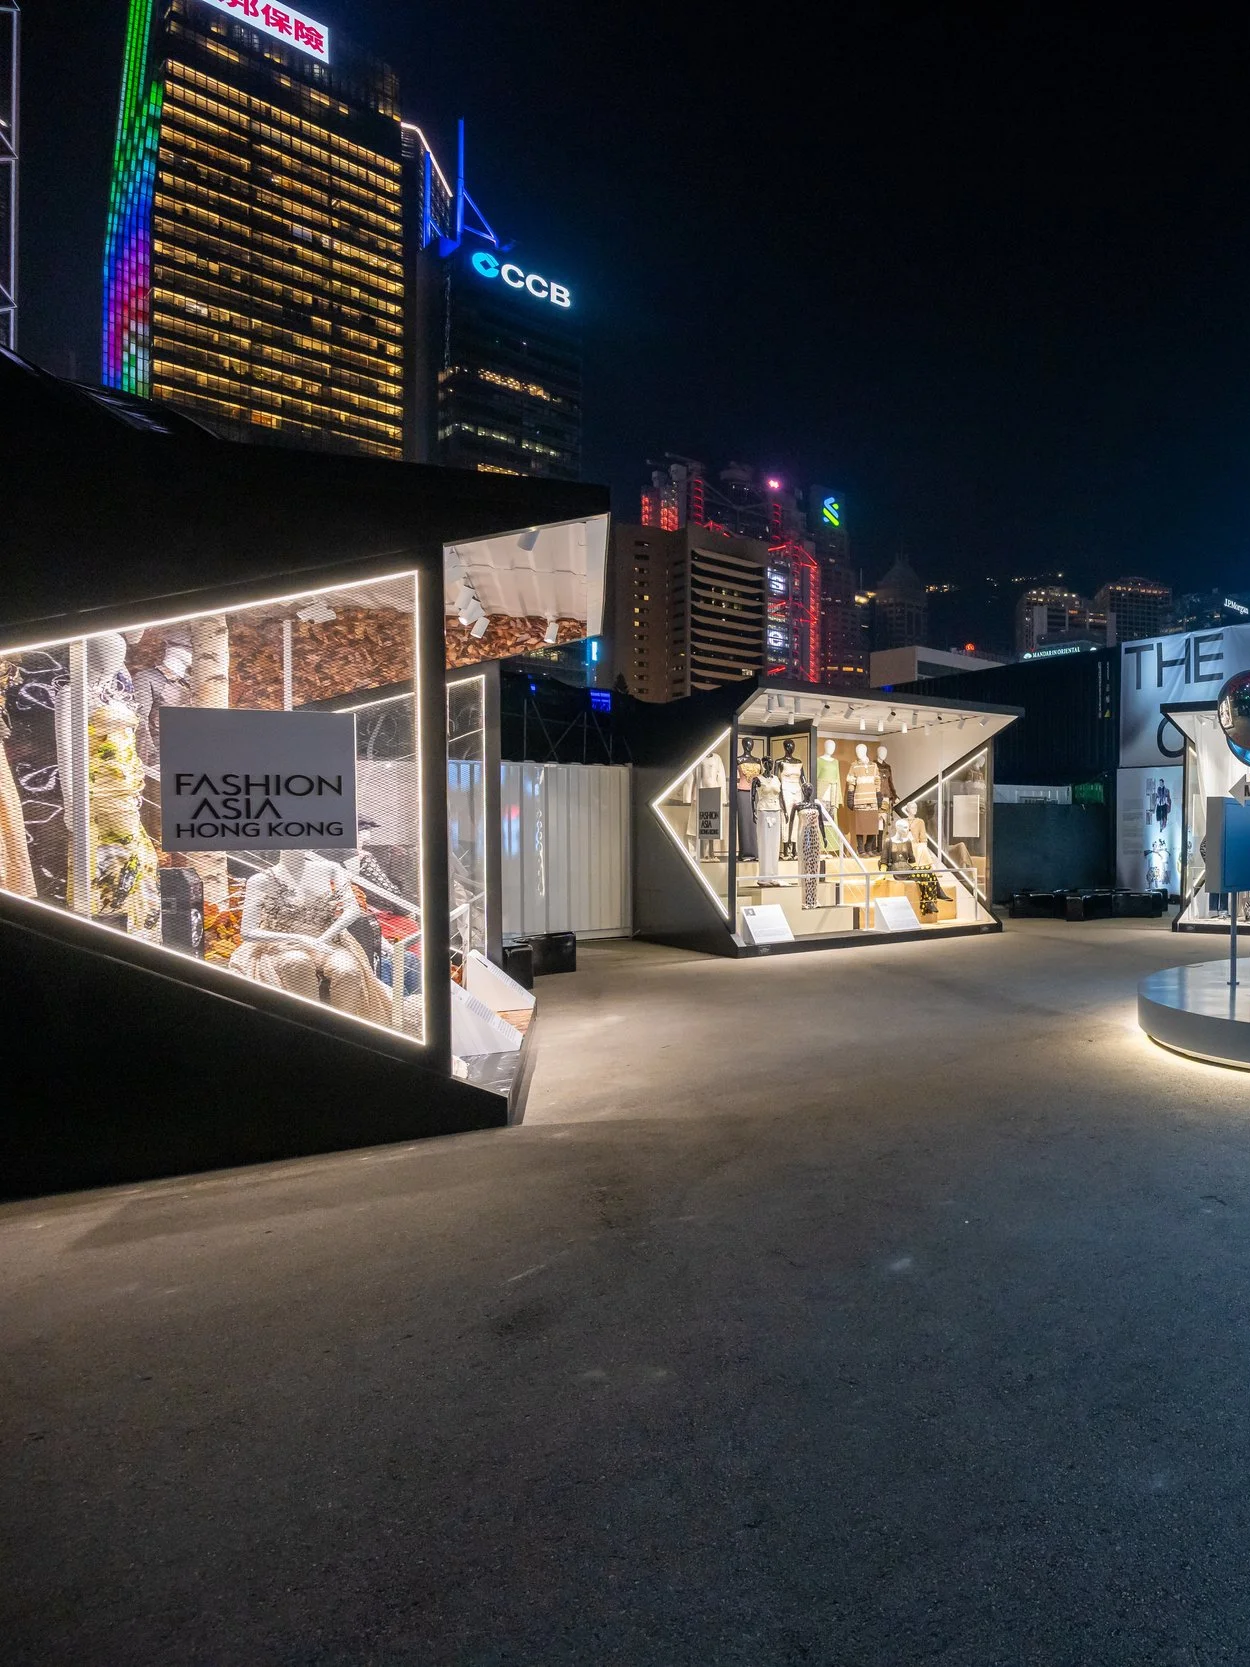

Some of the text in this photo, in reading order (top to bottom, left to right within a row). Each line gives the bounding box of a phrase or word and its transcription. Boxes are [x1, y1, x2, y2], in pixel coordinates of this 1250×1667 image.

[218, 0, 324, 53] 邦保險
[501, 264, 571, 308] CCB
[1125, 633, 1223, 690] THE
[175, 774, 342, 796] FASHION
[192, 798, 282, 819] ASIA
[176, 821, 343, 838] HONG KONG
